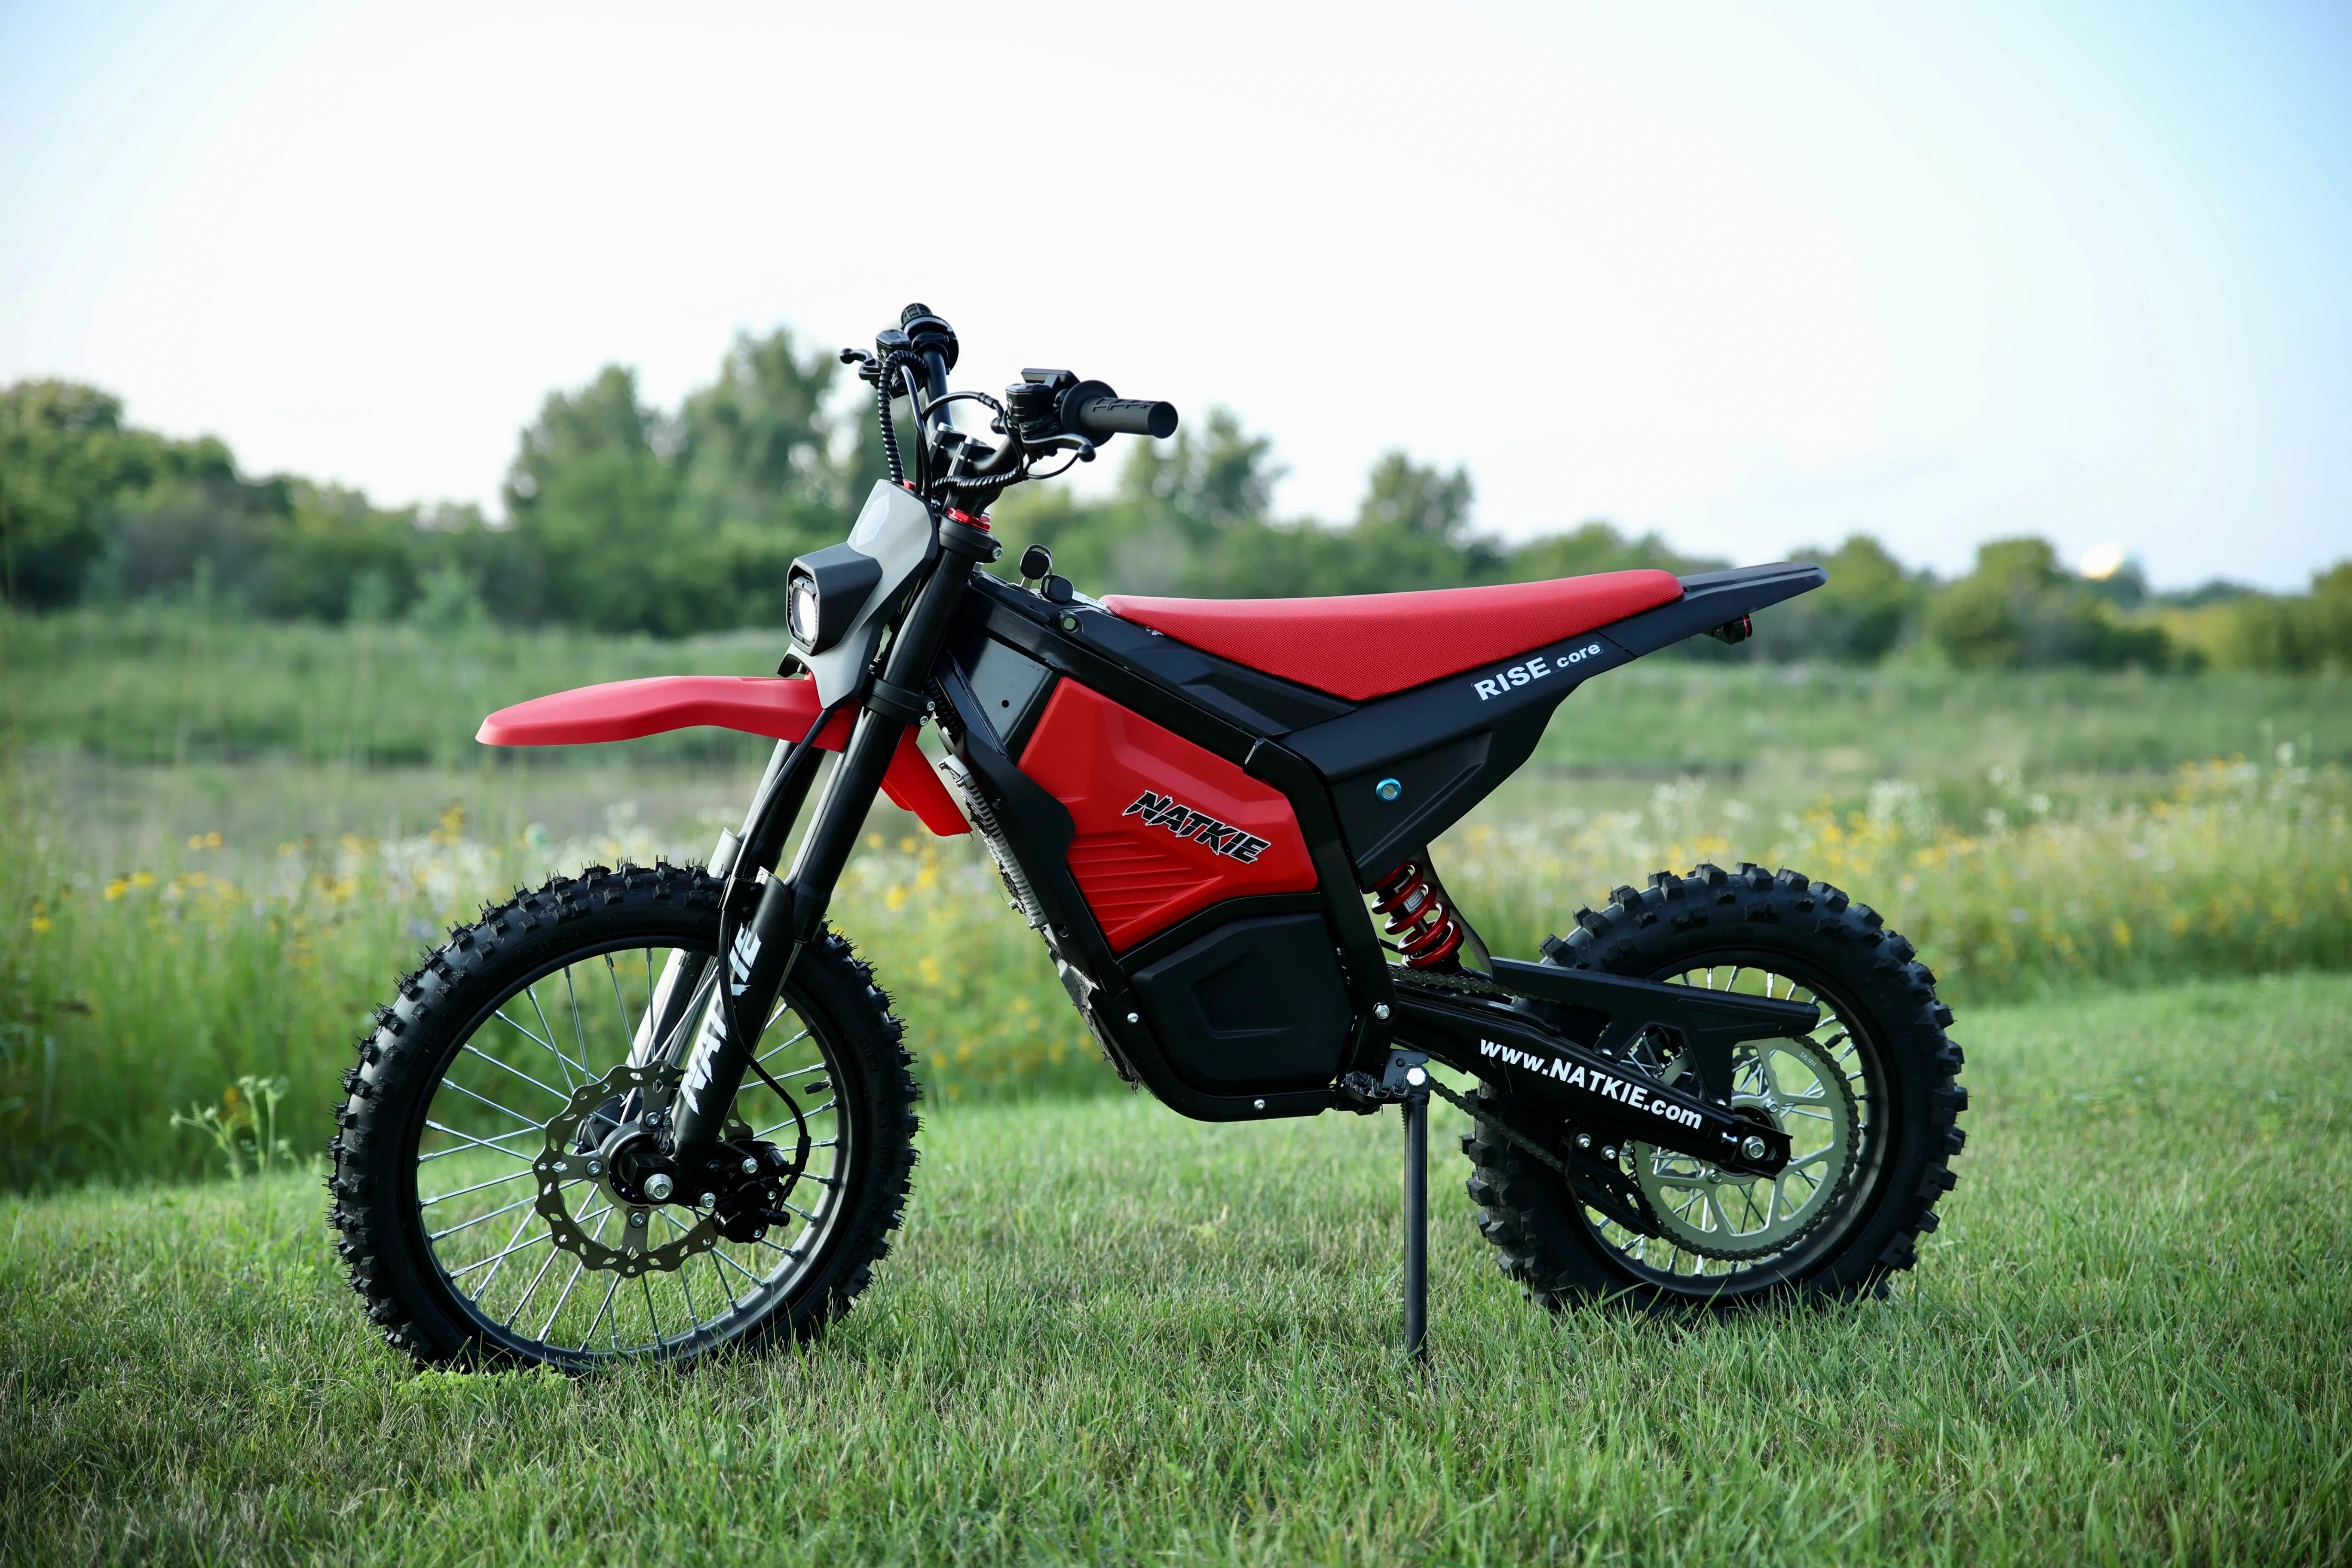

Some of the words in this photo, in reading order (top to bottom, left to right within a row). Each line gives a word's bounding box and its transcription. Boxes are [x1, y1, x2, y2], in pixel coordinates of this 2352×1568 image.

[1474, 657, 1551, 701] RISE
[1556, 644, 1601, 667] core
[1122, 790, 1271, 864] NATKIE
[1480, 1039, 1702, 1129] www.NATKIE.com
